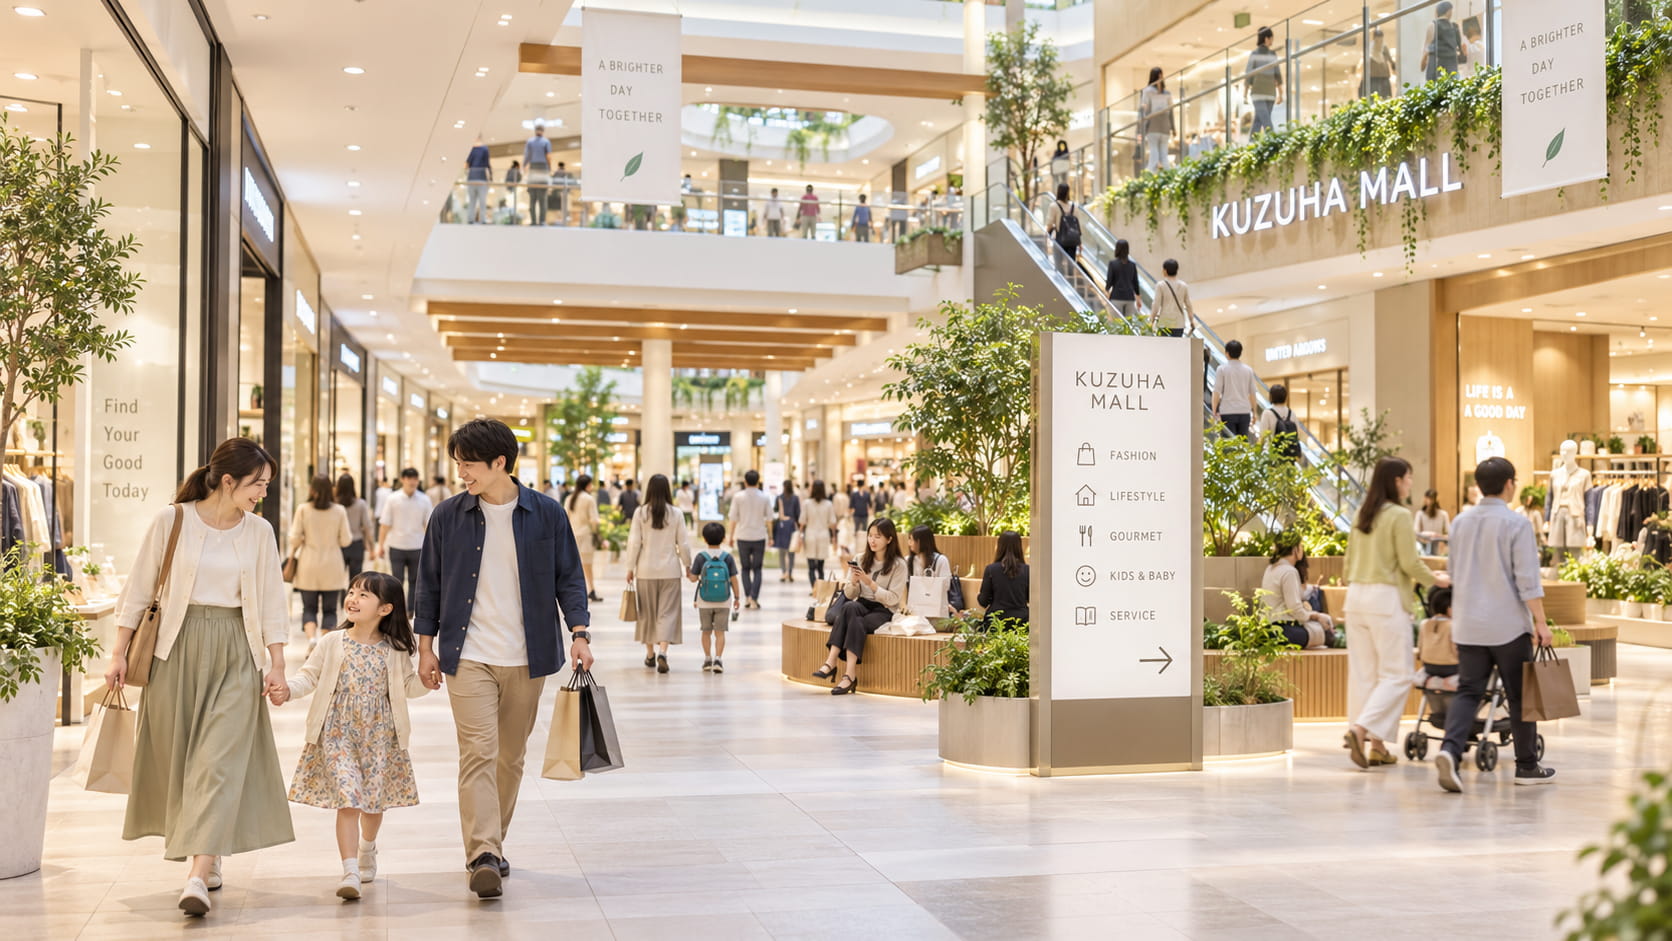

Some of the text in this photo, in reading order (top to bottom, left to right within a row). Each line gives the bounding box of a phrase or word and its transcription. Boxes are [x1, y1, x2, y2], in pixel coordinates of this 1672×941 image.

[1520, 22, 1584, 52] A BRIGHTER
[598, 60, 664, 74] A BRIGHTER
[1531, 57, 1554, 75] DAY
[610, 84, 633, 96] DAY
[1520, 77, 1584, 105] TOGETHER
[599, 108, 663, 123] TOGETHER
[1212, 152, 1463, 240] KUZUHA MALL
[1075, 370, 1166, 390] KUZUHA
[1465, 384, 1515, 400] LIFE IS A
[104, 398, 139, 414] Find
[1091, 393, 1150, 411] MALL
[1464, 404, 1527, 420] A GOOD DAY
[104, 426, 140, 442] Your
[103, 454, 143, 470] Good
[1110, 450, 1157, 461] FASHION
[103, 482, 147, 502] Today
[1110, 491, 1166, 502] LIFESTYLE
[1109, 531, 1164, 542] GOURMET
[1110, 570, 1176, 581] KIDS & BABY
[1110, 610, 1156, 621] SERVICE
